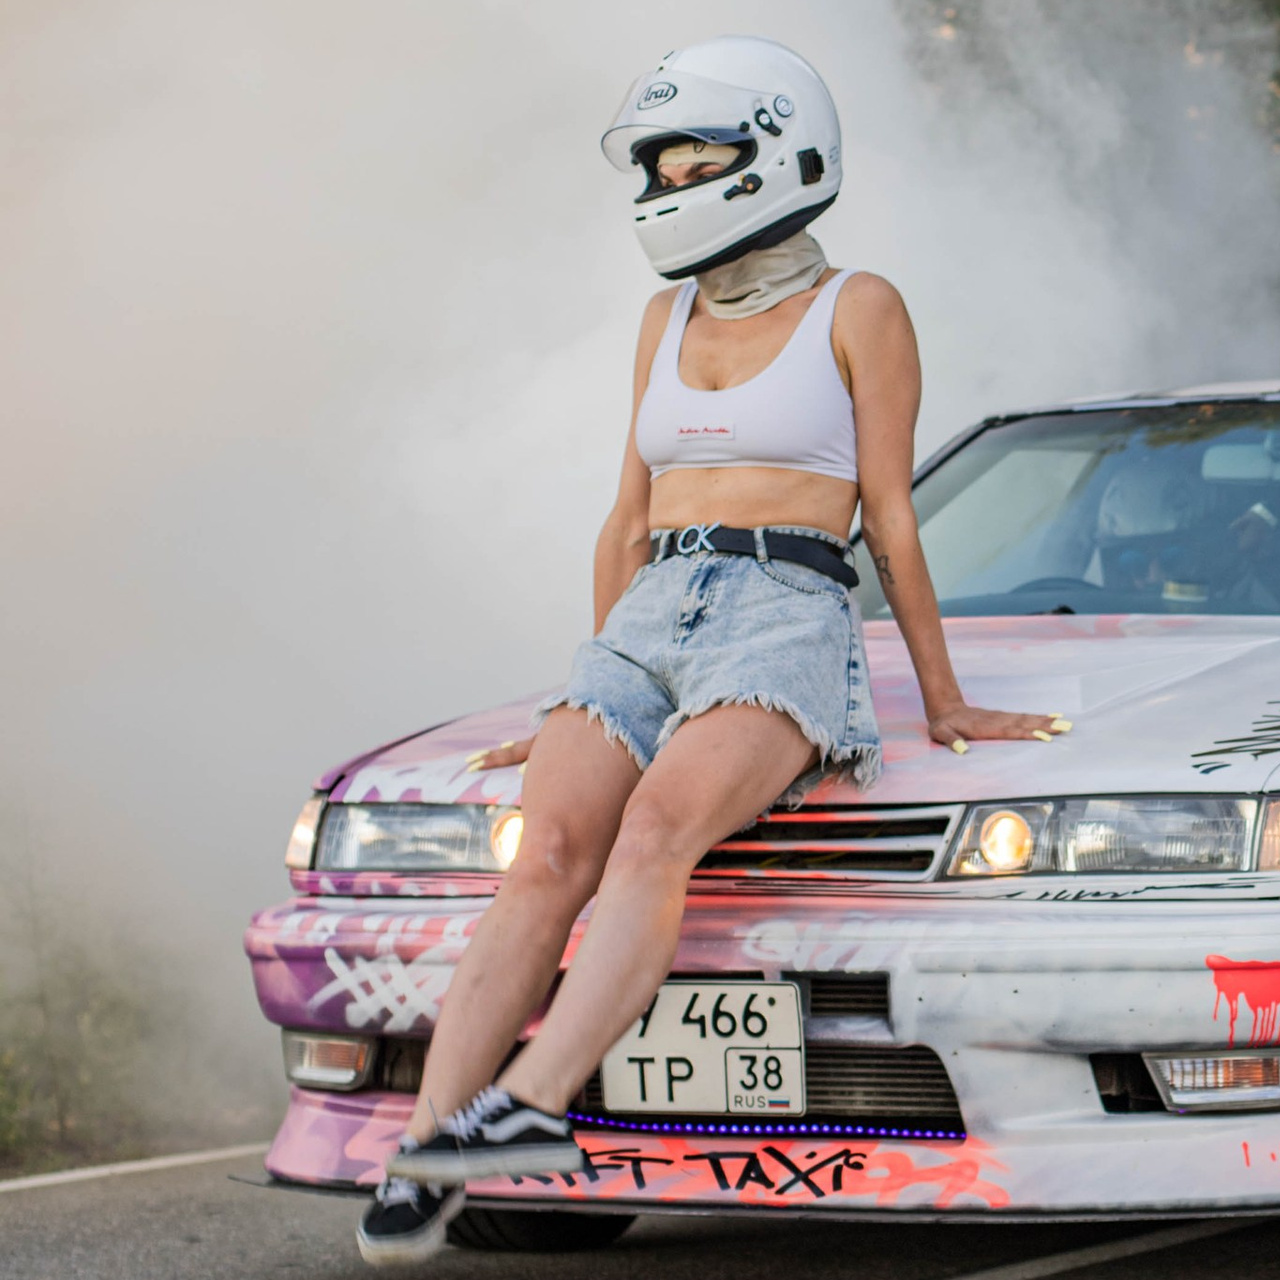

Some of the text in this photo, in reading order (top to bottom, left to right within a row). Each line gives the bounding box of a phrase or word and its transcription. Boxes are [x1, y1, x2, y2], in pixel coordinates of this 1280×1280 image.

[677, 520, 721, 554] CK
[681, 993, 768, 1038] 466
[739, 1055, 783, 1090] 38
[734, 1095, 767, 1108] RUS
